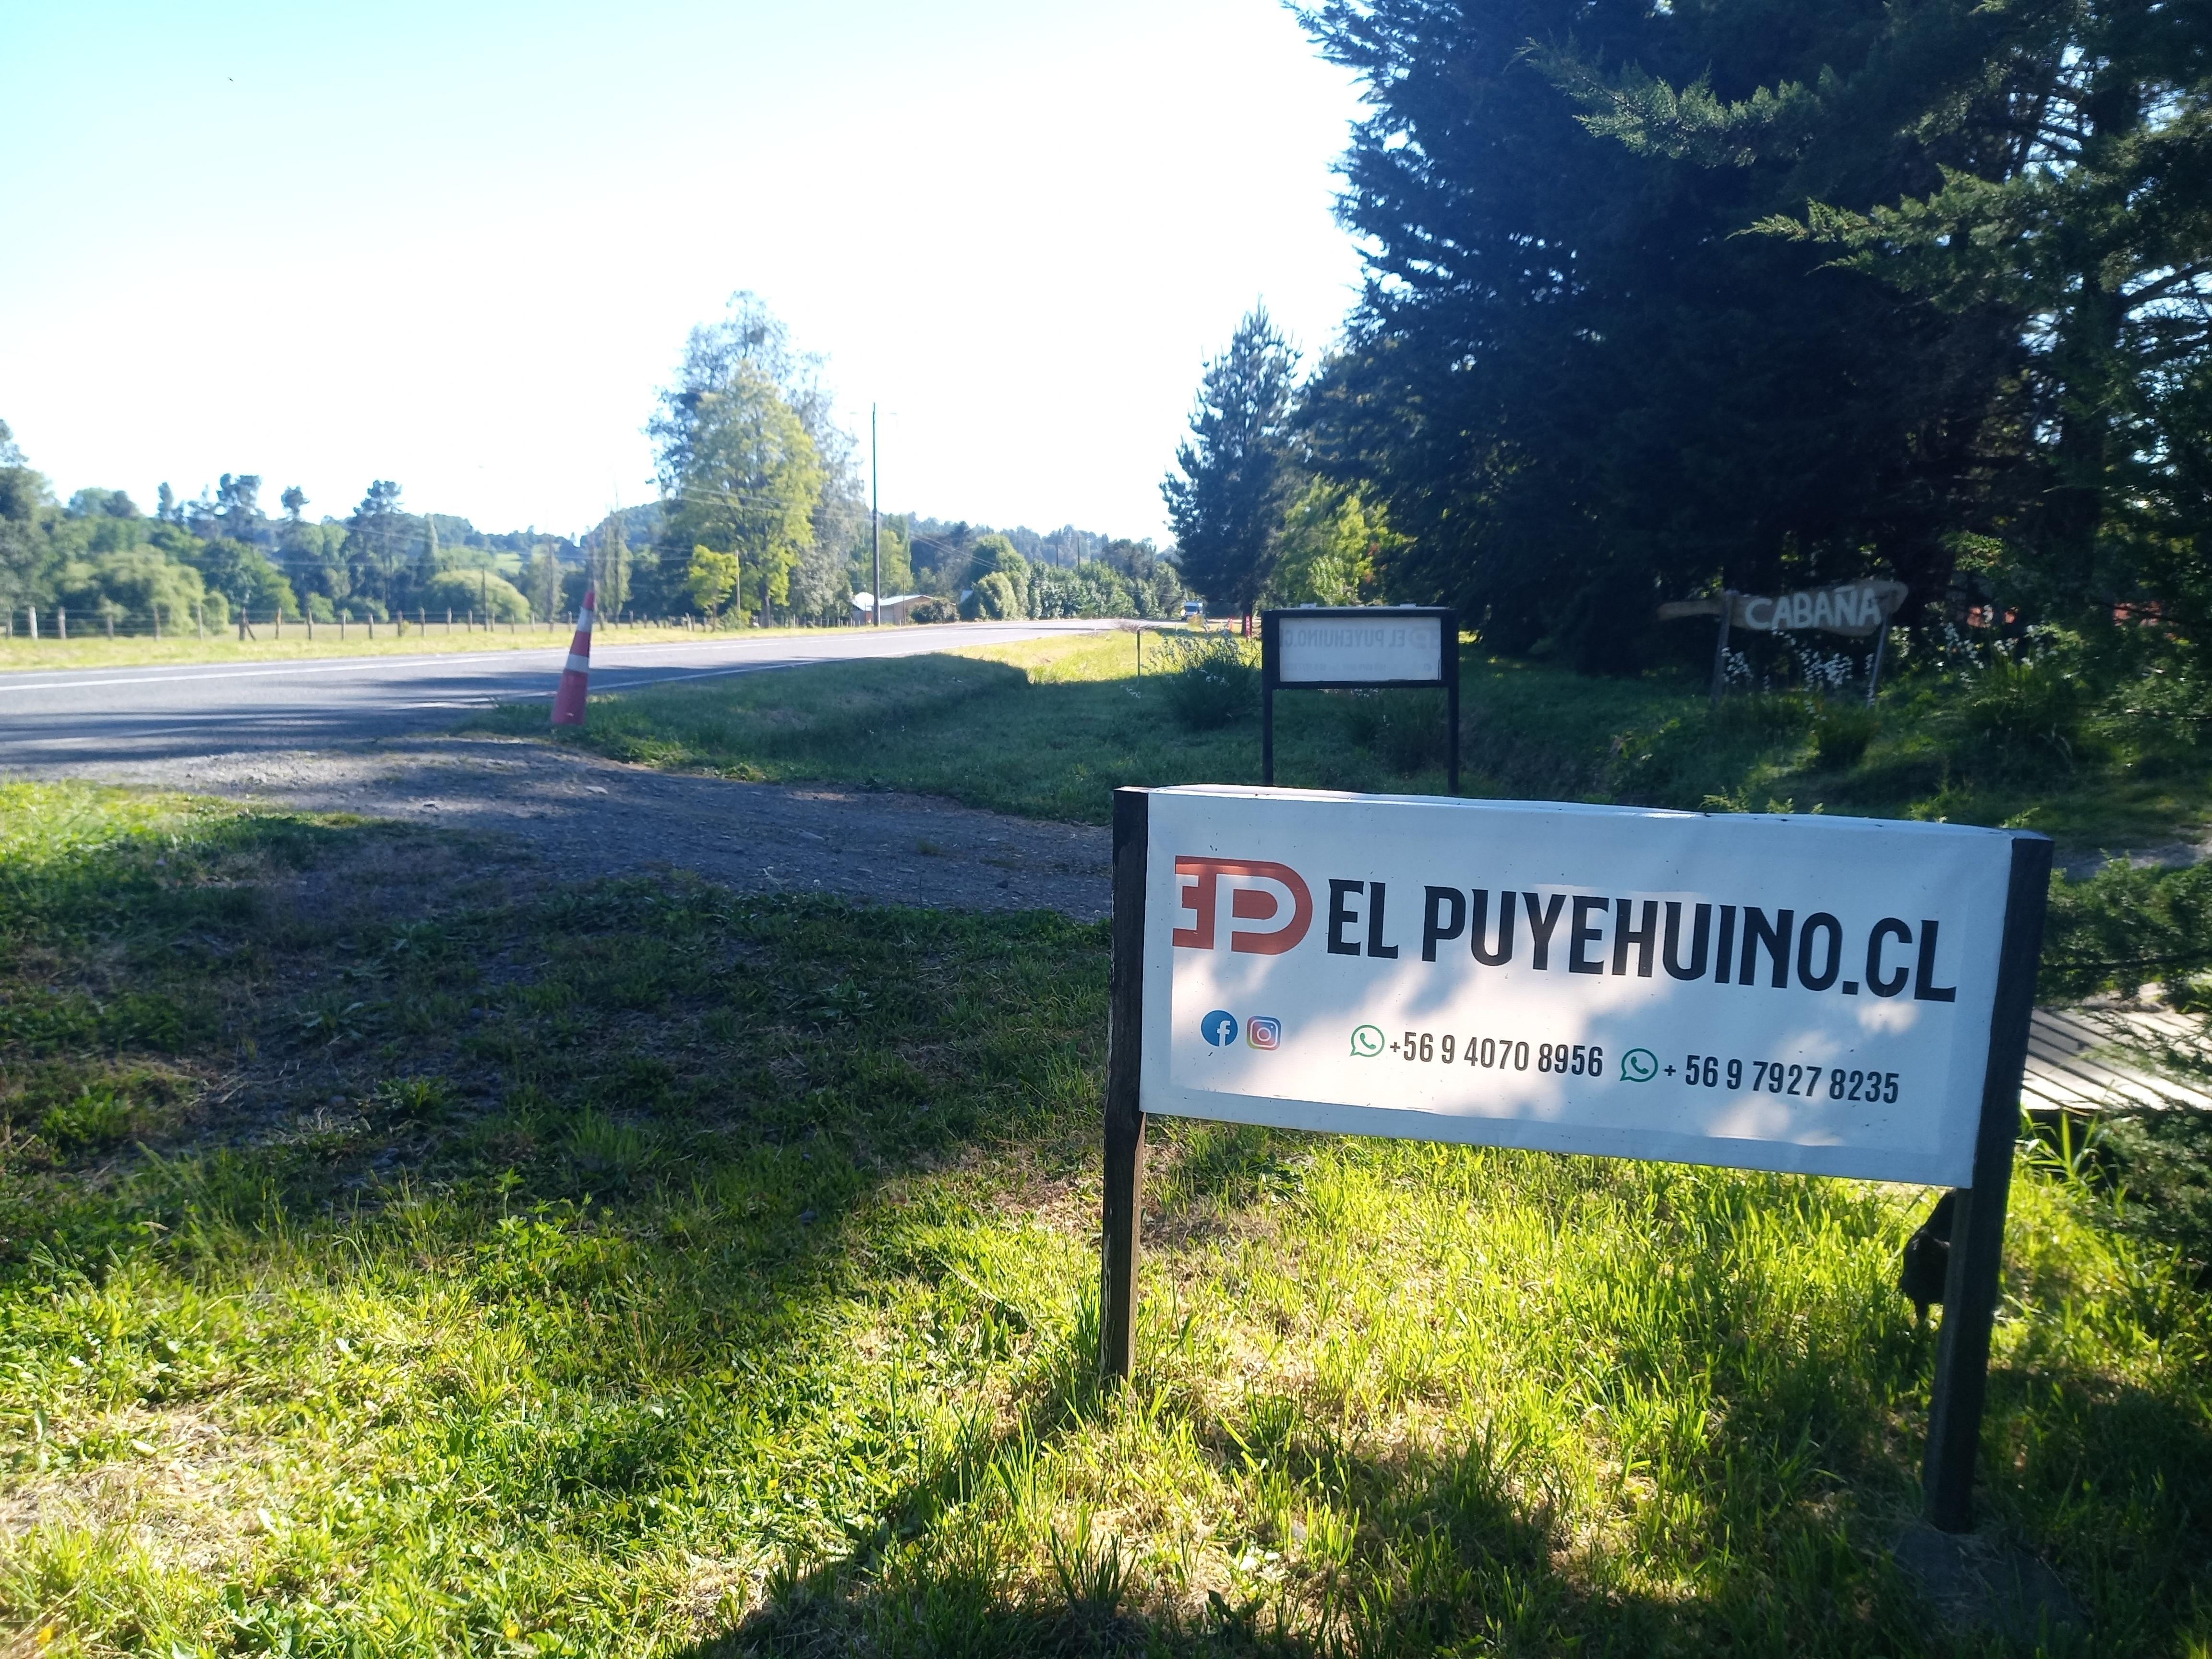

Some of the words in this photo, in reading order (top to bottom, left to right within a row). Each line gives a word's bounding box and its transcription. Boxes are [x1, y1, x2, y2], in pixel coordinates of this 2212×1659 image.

[1744, 585, 1882, 630] CABAÑA
[1327, 878, 1399, 959] EL
[1422, 885, 1957, 1003] PUYEHUINO.CL
[1390, 1032, 1433, 1063] +56
[1441, 1034, 1455, 1064] 9
[1464, 1037, 1529, 1071] 4070
[1538, 1044, 1603, 1077] 8956
[1685, 1055, 1719, 1088] 56
[1726, 1058, 1743, 1090] 9
[1752, 1061, 1822, 1096] 7927
[1829, 1069, 1899, 1104] 8235
